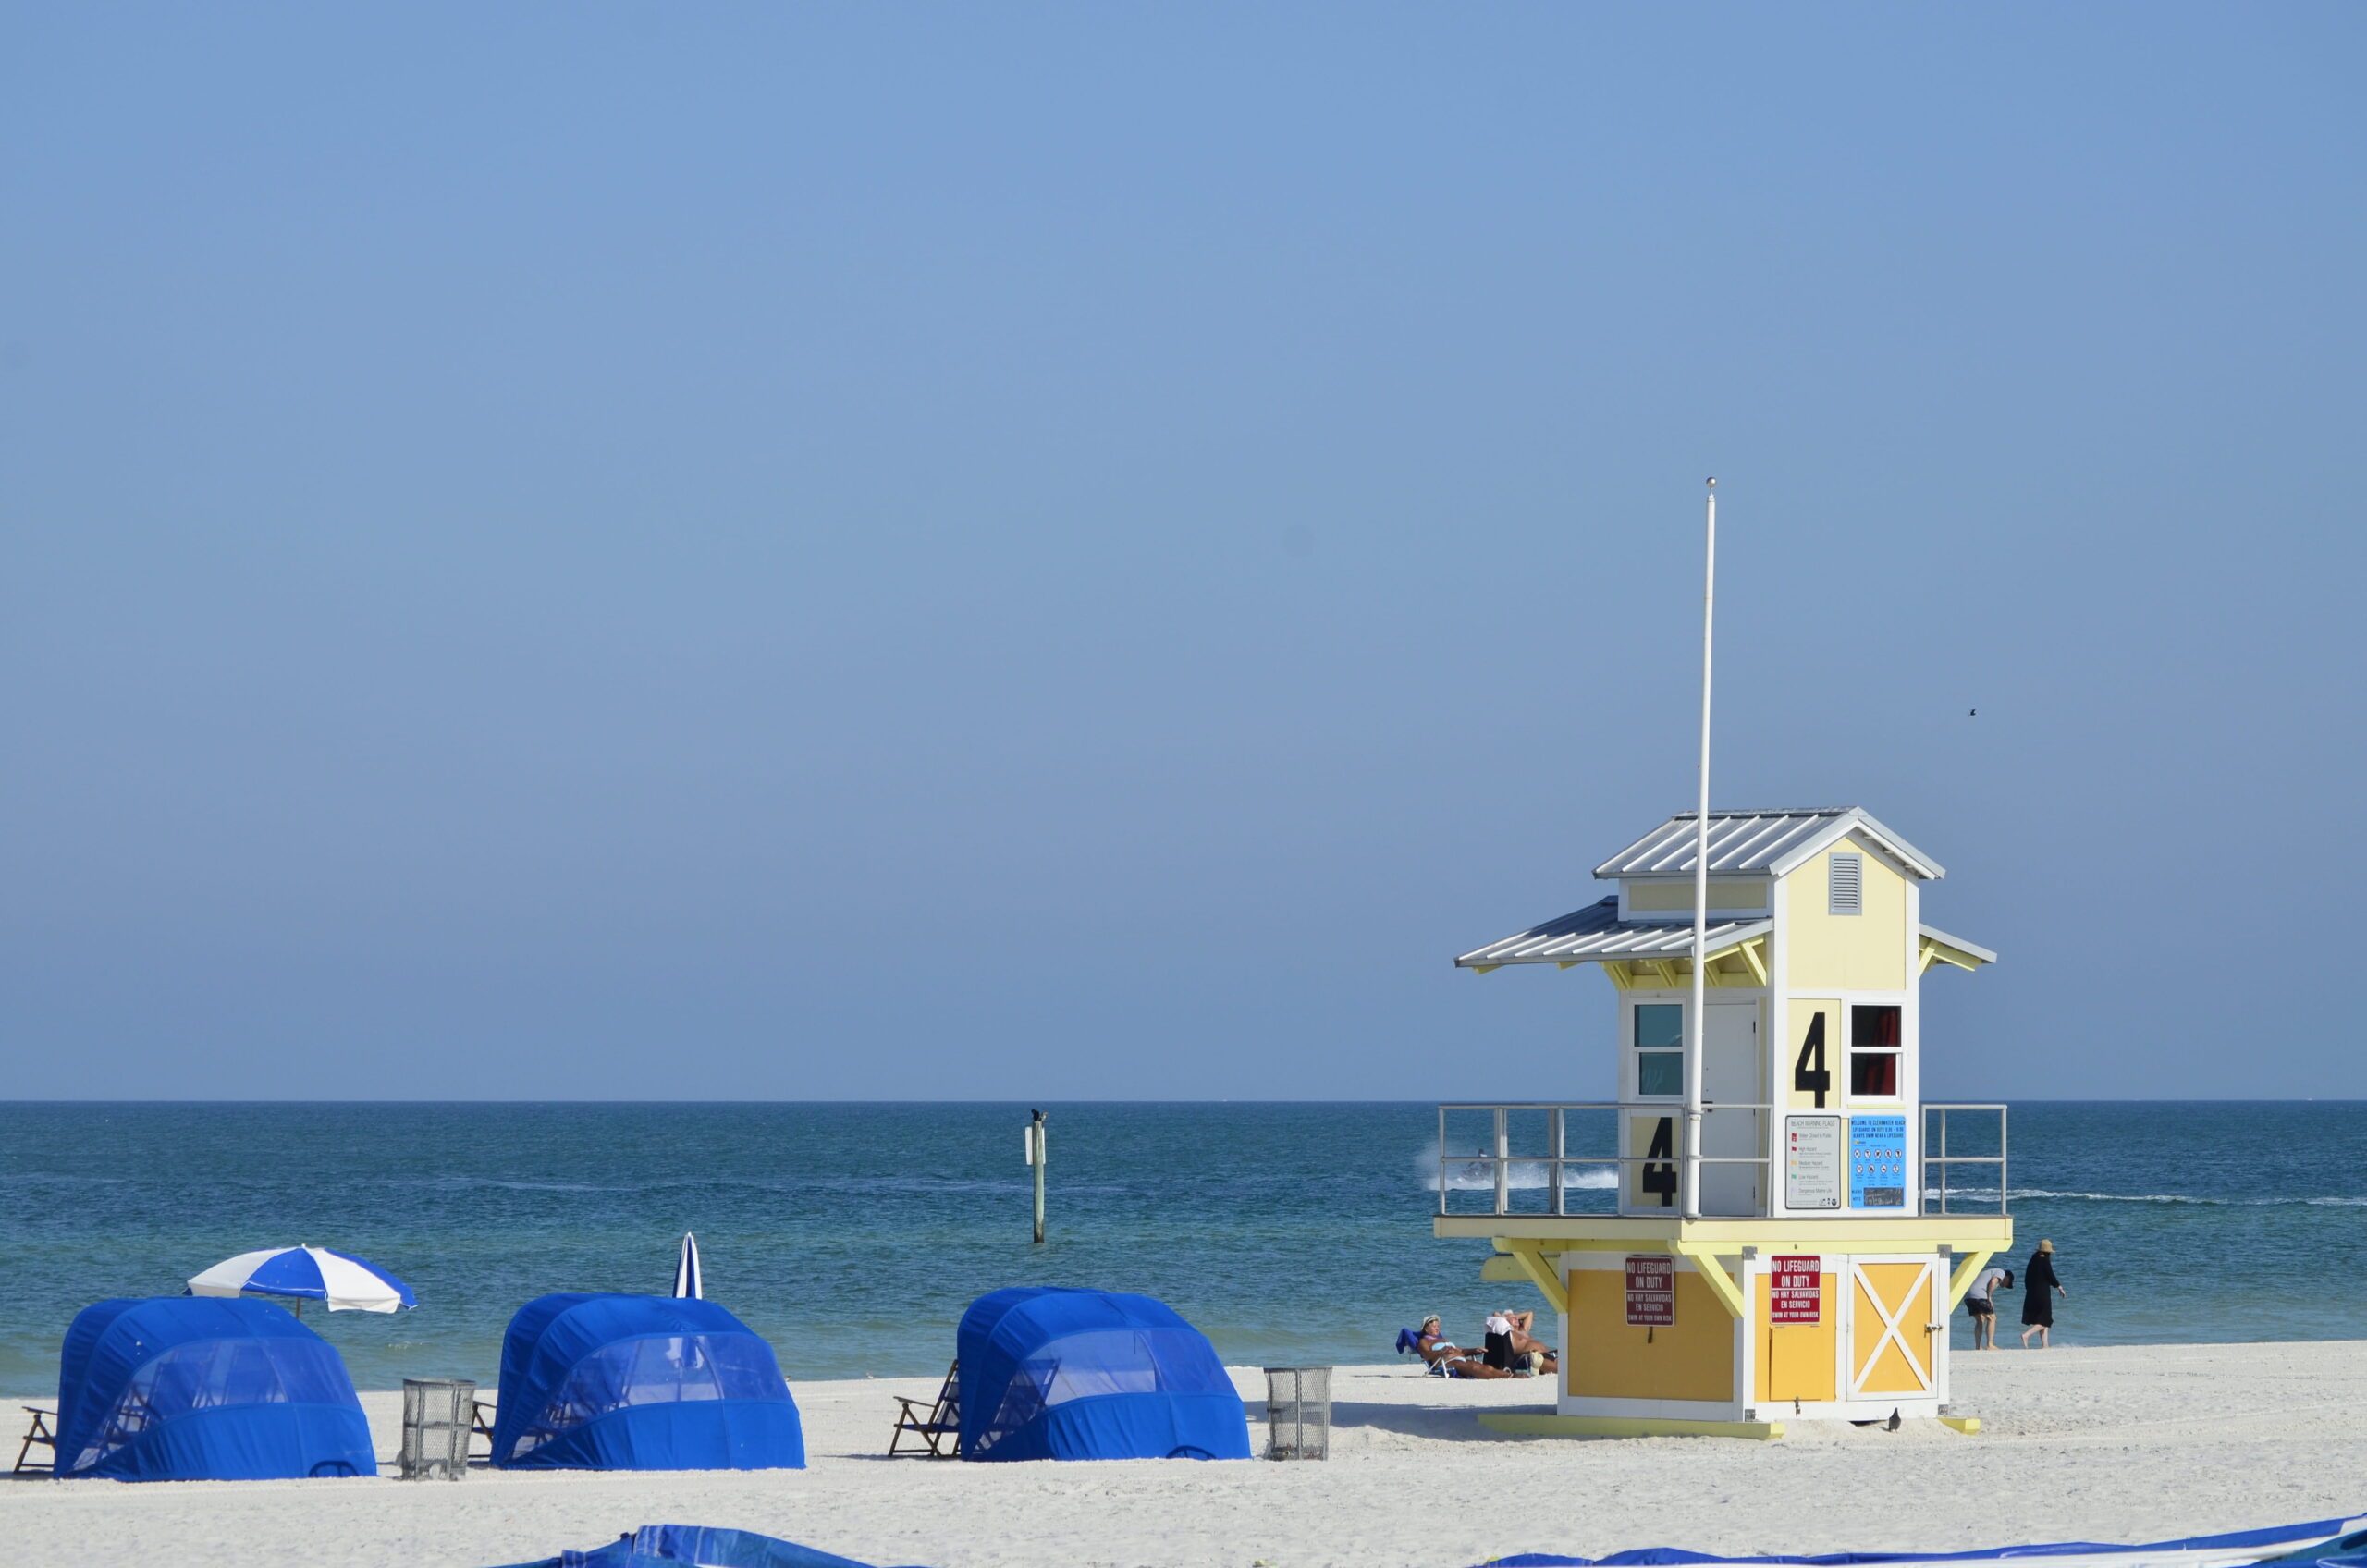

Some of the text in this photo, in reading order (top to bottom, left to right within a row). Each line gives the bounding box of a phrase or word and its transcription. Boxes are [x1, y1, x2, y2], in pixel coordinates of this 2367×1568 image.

[1795, 1012, 1830, 1109] 4
[1643, 1117, 1677, 1207] 4
[1627, 1262, 1671, 1275] NO LIFEGUARD
[1772, 1260, 1820, 1273] NO LIFEGUARD
[1635, 1276, 1662, 1289] ON DUTY
[1781, 1275, 1810, 1288] ON DUTY
[1627, 1293, 1672, 1303] NO HAY SALVAVIDAS
[1772, 1291, 1819, 1299] NO HAY SALVAVIDAS
[1635, 1303, 1664, 1312] EN SERVICIO
[1781, 1300, 1810, 1309] EN SERVICIO
[1644, 1314, 1653, 1322] YOUR
[1654, 1314, 1662, 1322] OWN
